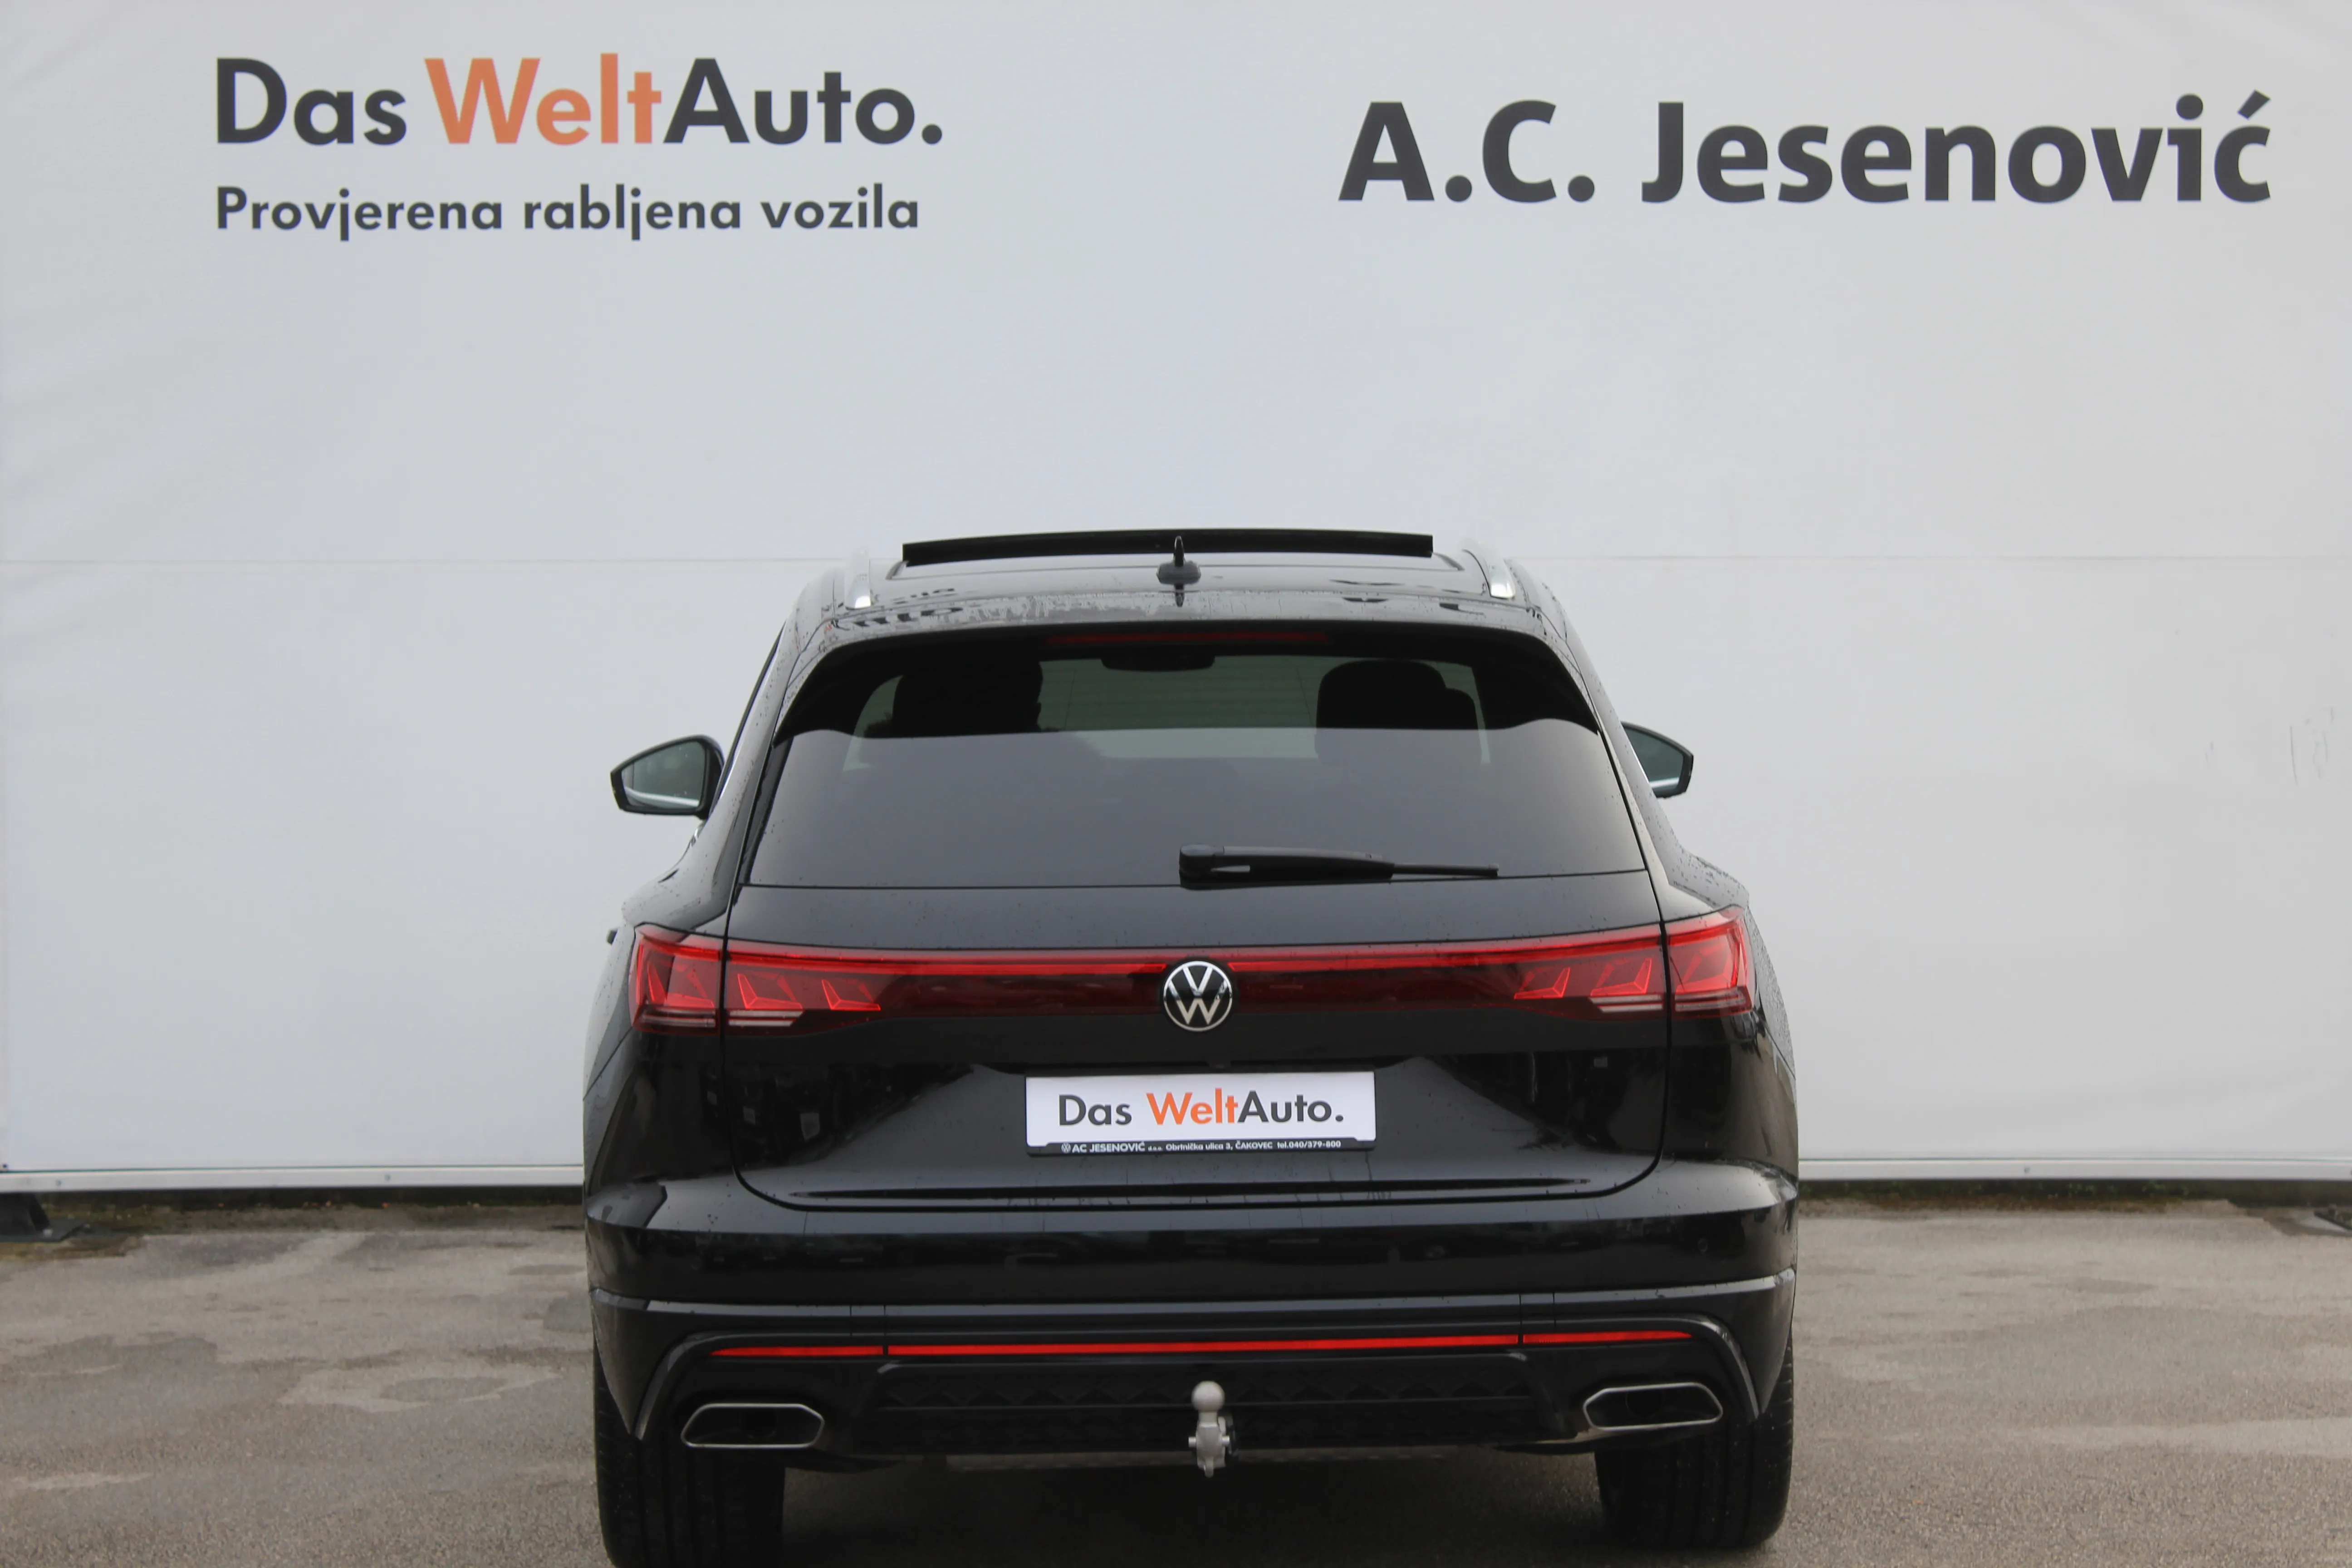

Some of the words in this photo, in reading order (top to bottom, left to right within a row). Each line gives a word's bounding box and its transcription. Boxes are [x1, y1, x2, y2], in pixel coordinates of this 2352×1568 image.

[217, 58, 407, 147] Das
[425, 53, 943, 146] WeltAuto.
[1338, 100, 1596, 204] A.C.
[1642, 90, 2271, 204] Jesenović
[217, 186, 502, 242] Provjerena
[524, 184, 741, 241] rabljena
[760, 183, 919, 230] vozila
[1059, 1095, 1132, 1126] Das
[1147, 1088, 1344, 1125] WeltAuto.
[1072, 1143, 1087, 1153] AC
[1089, 1141, 1146, 1153] JESENOVIĆ
[1166, 1142, 1203, 1151] Obrtnička
[1205, 1142, 1224, 1151] ulica
[1235, 1140, 1273, 1150] ČAKOVEC
